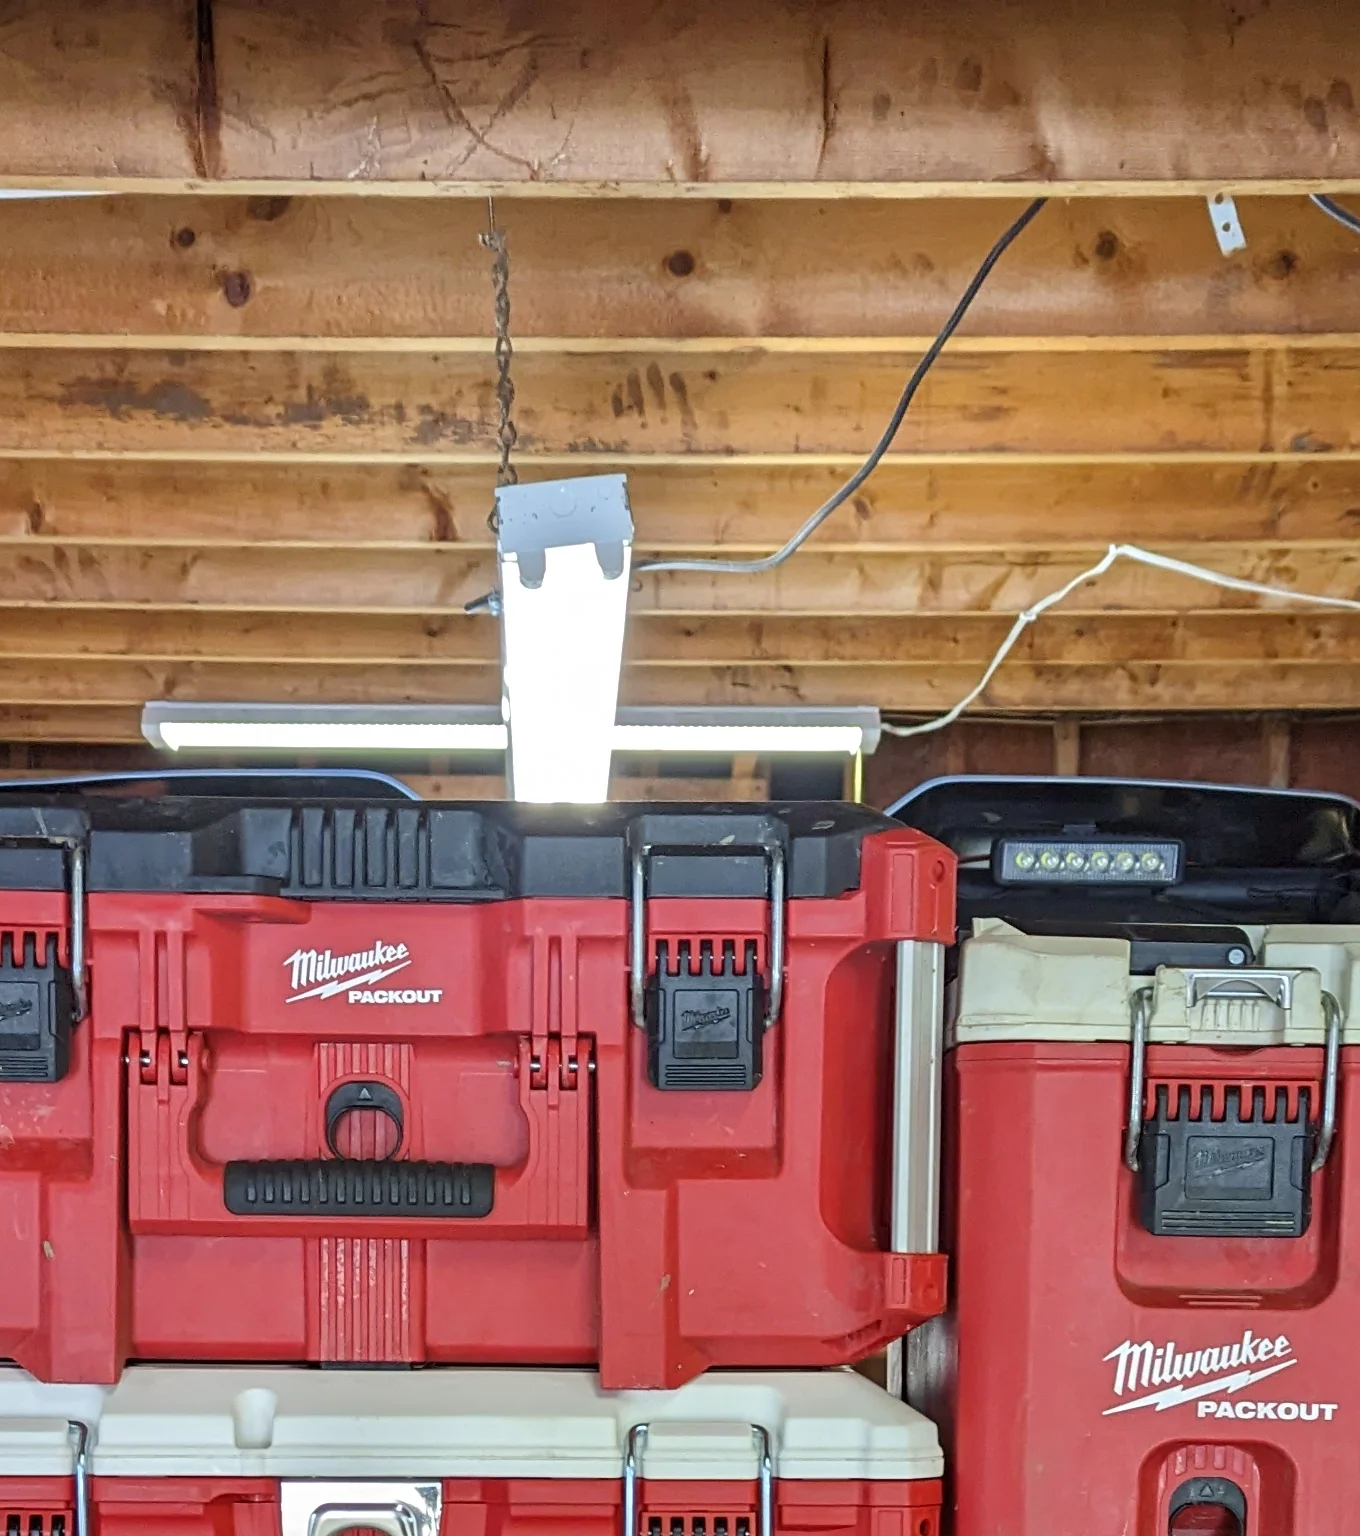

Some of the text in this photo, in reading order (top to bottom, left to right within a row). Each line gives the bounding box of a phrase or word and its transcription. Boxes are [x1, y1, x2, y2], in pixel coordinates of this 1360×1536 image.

[283, 940, 409, 990] Milwaukee
[348, 990, 442, 1004] PACKOUT
[1102, 1331, 1292, 1396] Milwaukee
[1197, 1401, 1338, 1420] PACKOUT
